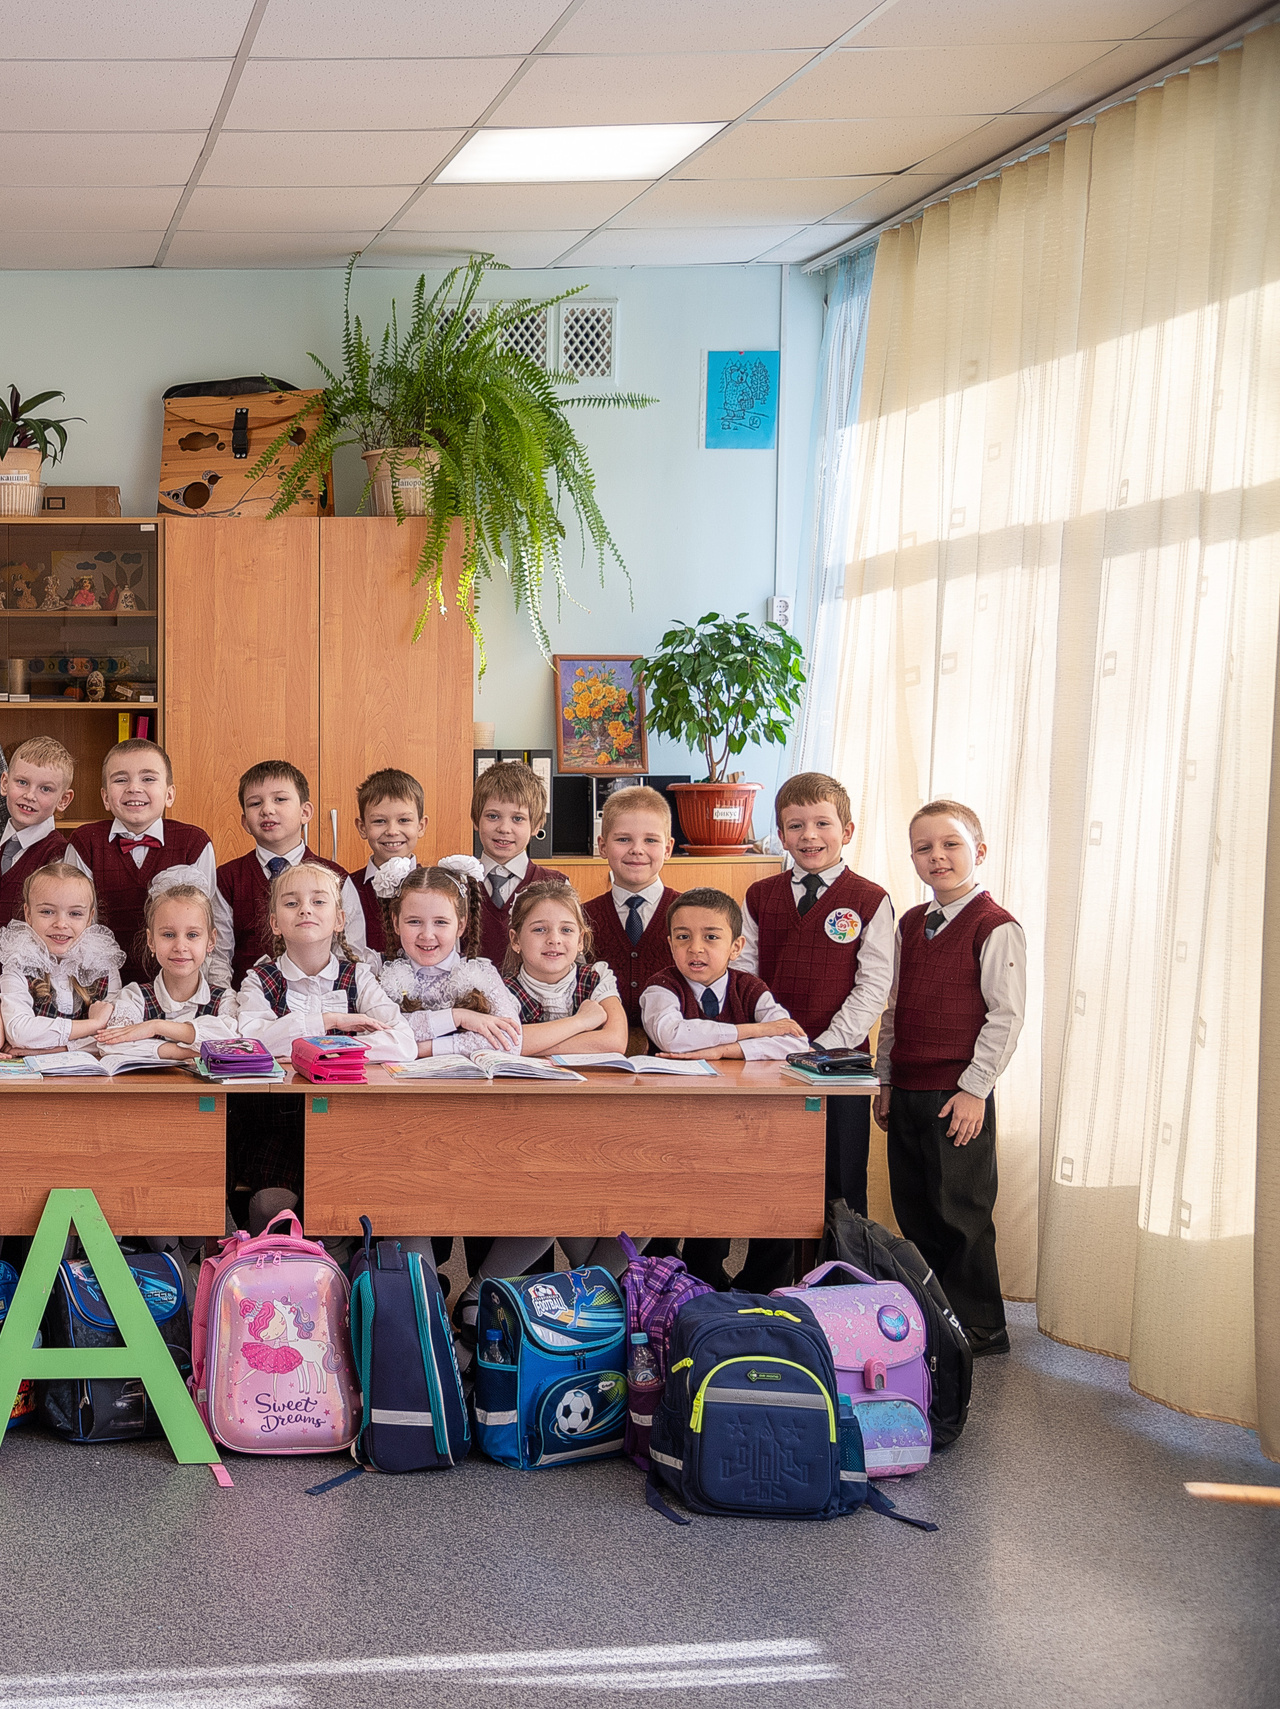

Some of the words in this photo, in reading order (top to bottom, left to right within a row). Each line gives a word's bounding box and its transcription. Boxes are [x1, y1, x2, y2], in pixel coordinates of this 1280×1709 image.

[714, 809, 738, 818] фикус
[533, 1297, 569, 1316] FOOTBALL
[255, 1393, 318, 1413] Sweet
[260, 1413, 326, 1433] Dreams
